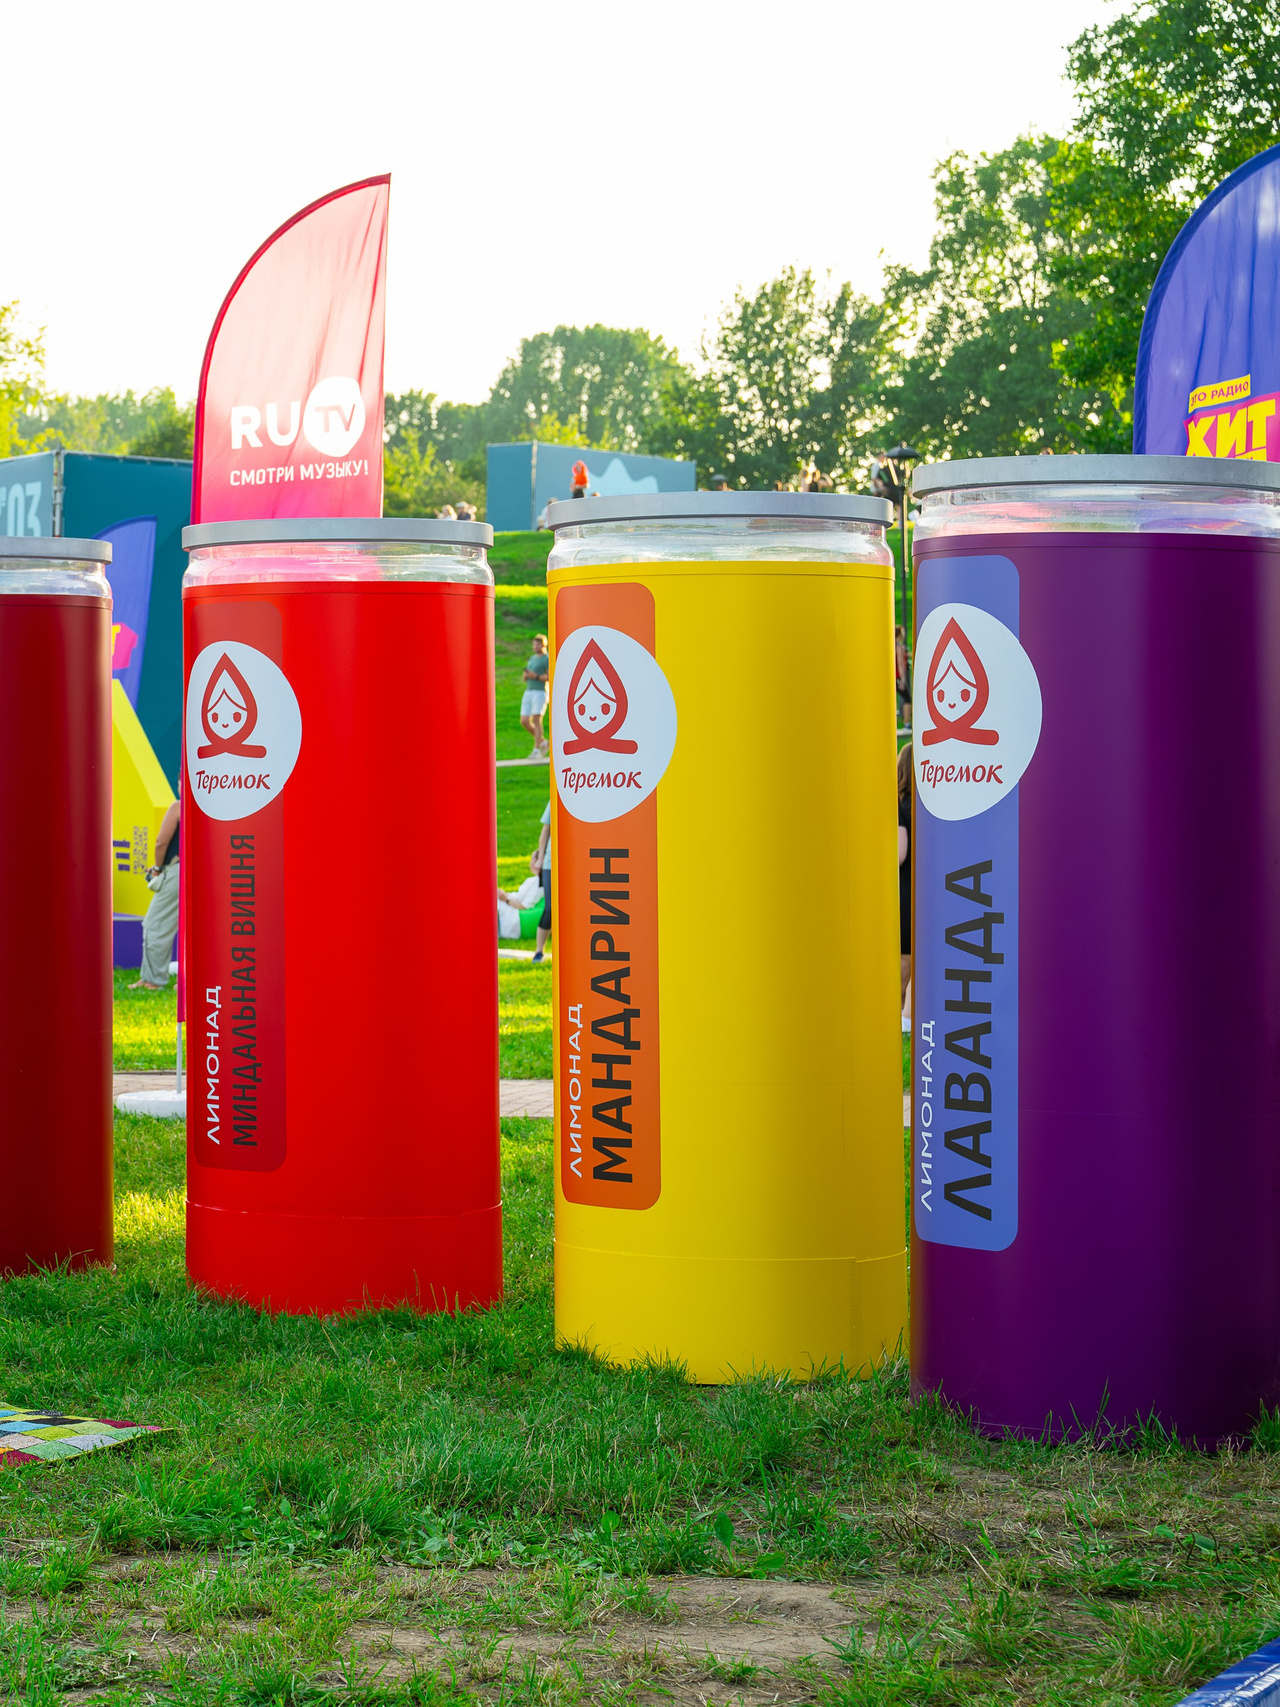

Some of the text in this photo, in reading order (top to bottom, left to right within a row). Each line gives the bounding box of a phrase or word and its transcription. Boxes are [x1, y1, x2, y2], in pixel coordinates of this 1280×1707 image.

[1211, 381, 1249, 400] РАДИО
[231, 400, 301, 450] RU
[1185, 399, 1276, 459] ХИТ
[230, 459, 369, 486] СМОТРИ МУЗЫКУ!
[196, 769, 271, 794] Теремок
[561, 767, 642, 794] Теремок
[920, 759, 1003, 788] Теремок
[230, 834, 263, 1147] МИНДАЛЬНАЯ ВИШНЯ
[589, 848, 641, 1184] МАНДАРИН
[206, 985, 222, 1146] ЛИМОНАД
[943, 859, 1005, 1222] ЛАВАНДА
[568, 1003, 583, 1178] ЛИМОНАД
[920, 1020, 936, 1213] ЛИМОНАД
